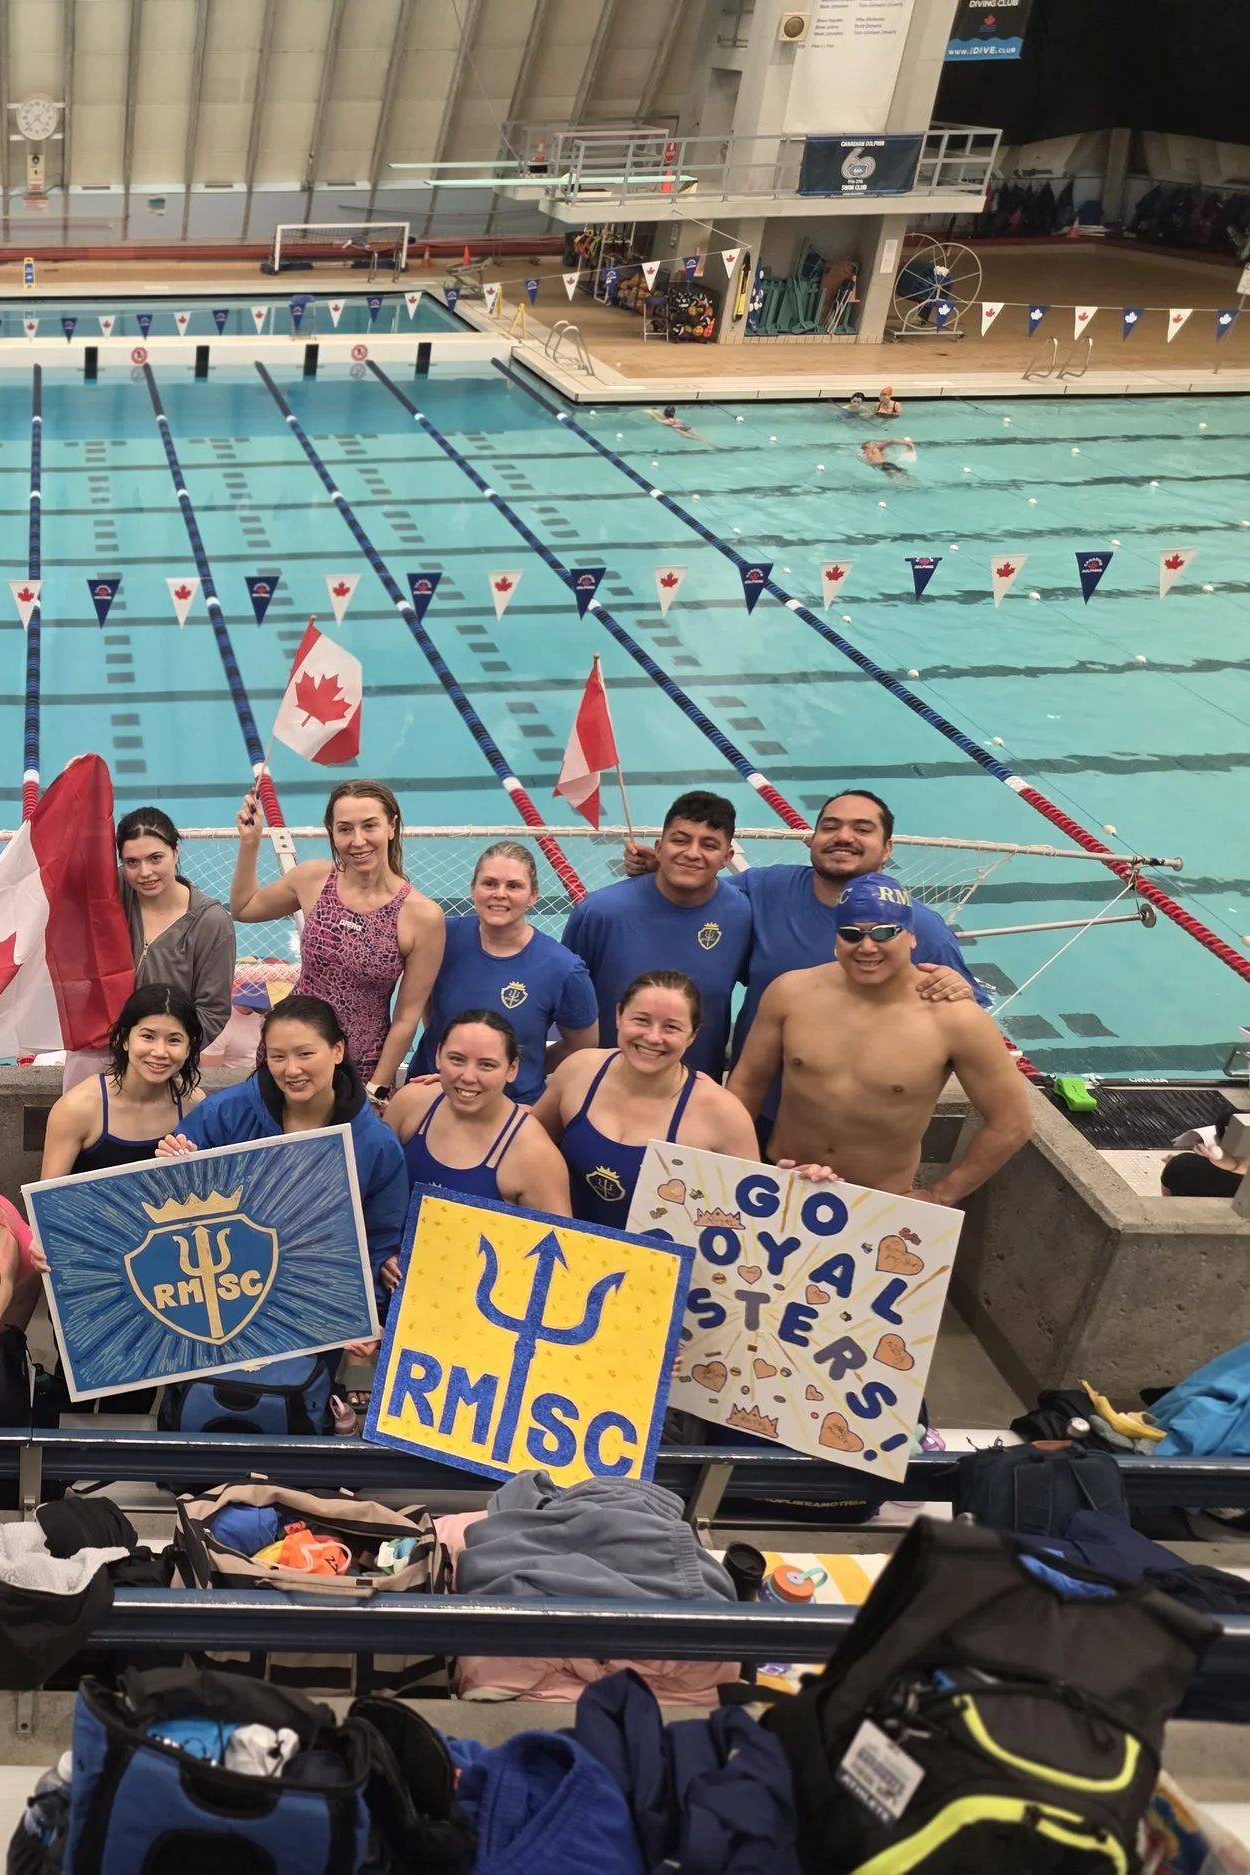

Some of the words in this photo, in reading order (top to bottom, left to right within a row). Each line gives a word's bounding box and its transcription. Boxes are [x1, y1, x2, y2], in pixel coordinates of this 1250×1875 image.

[969, 0, 996, 8] DIVING
[735, 1174, 849, 1237] GO
[639, 1227, 908, 1325] OYAL
